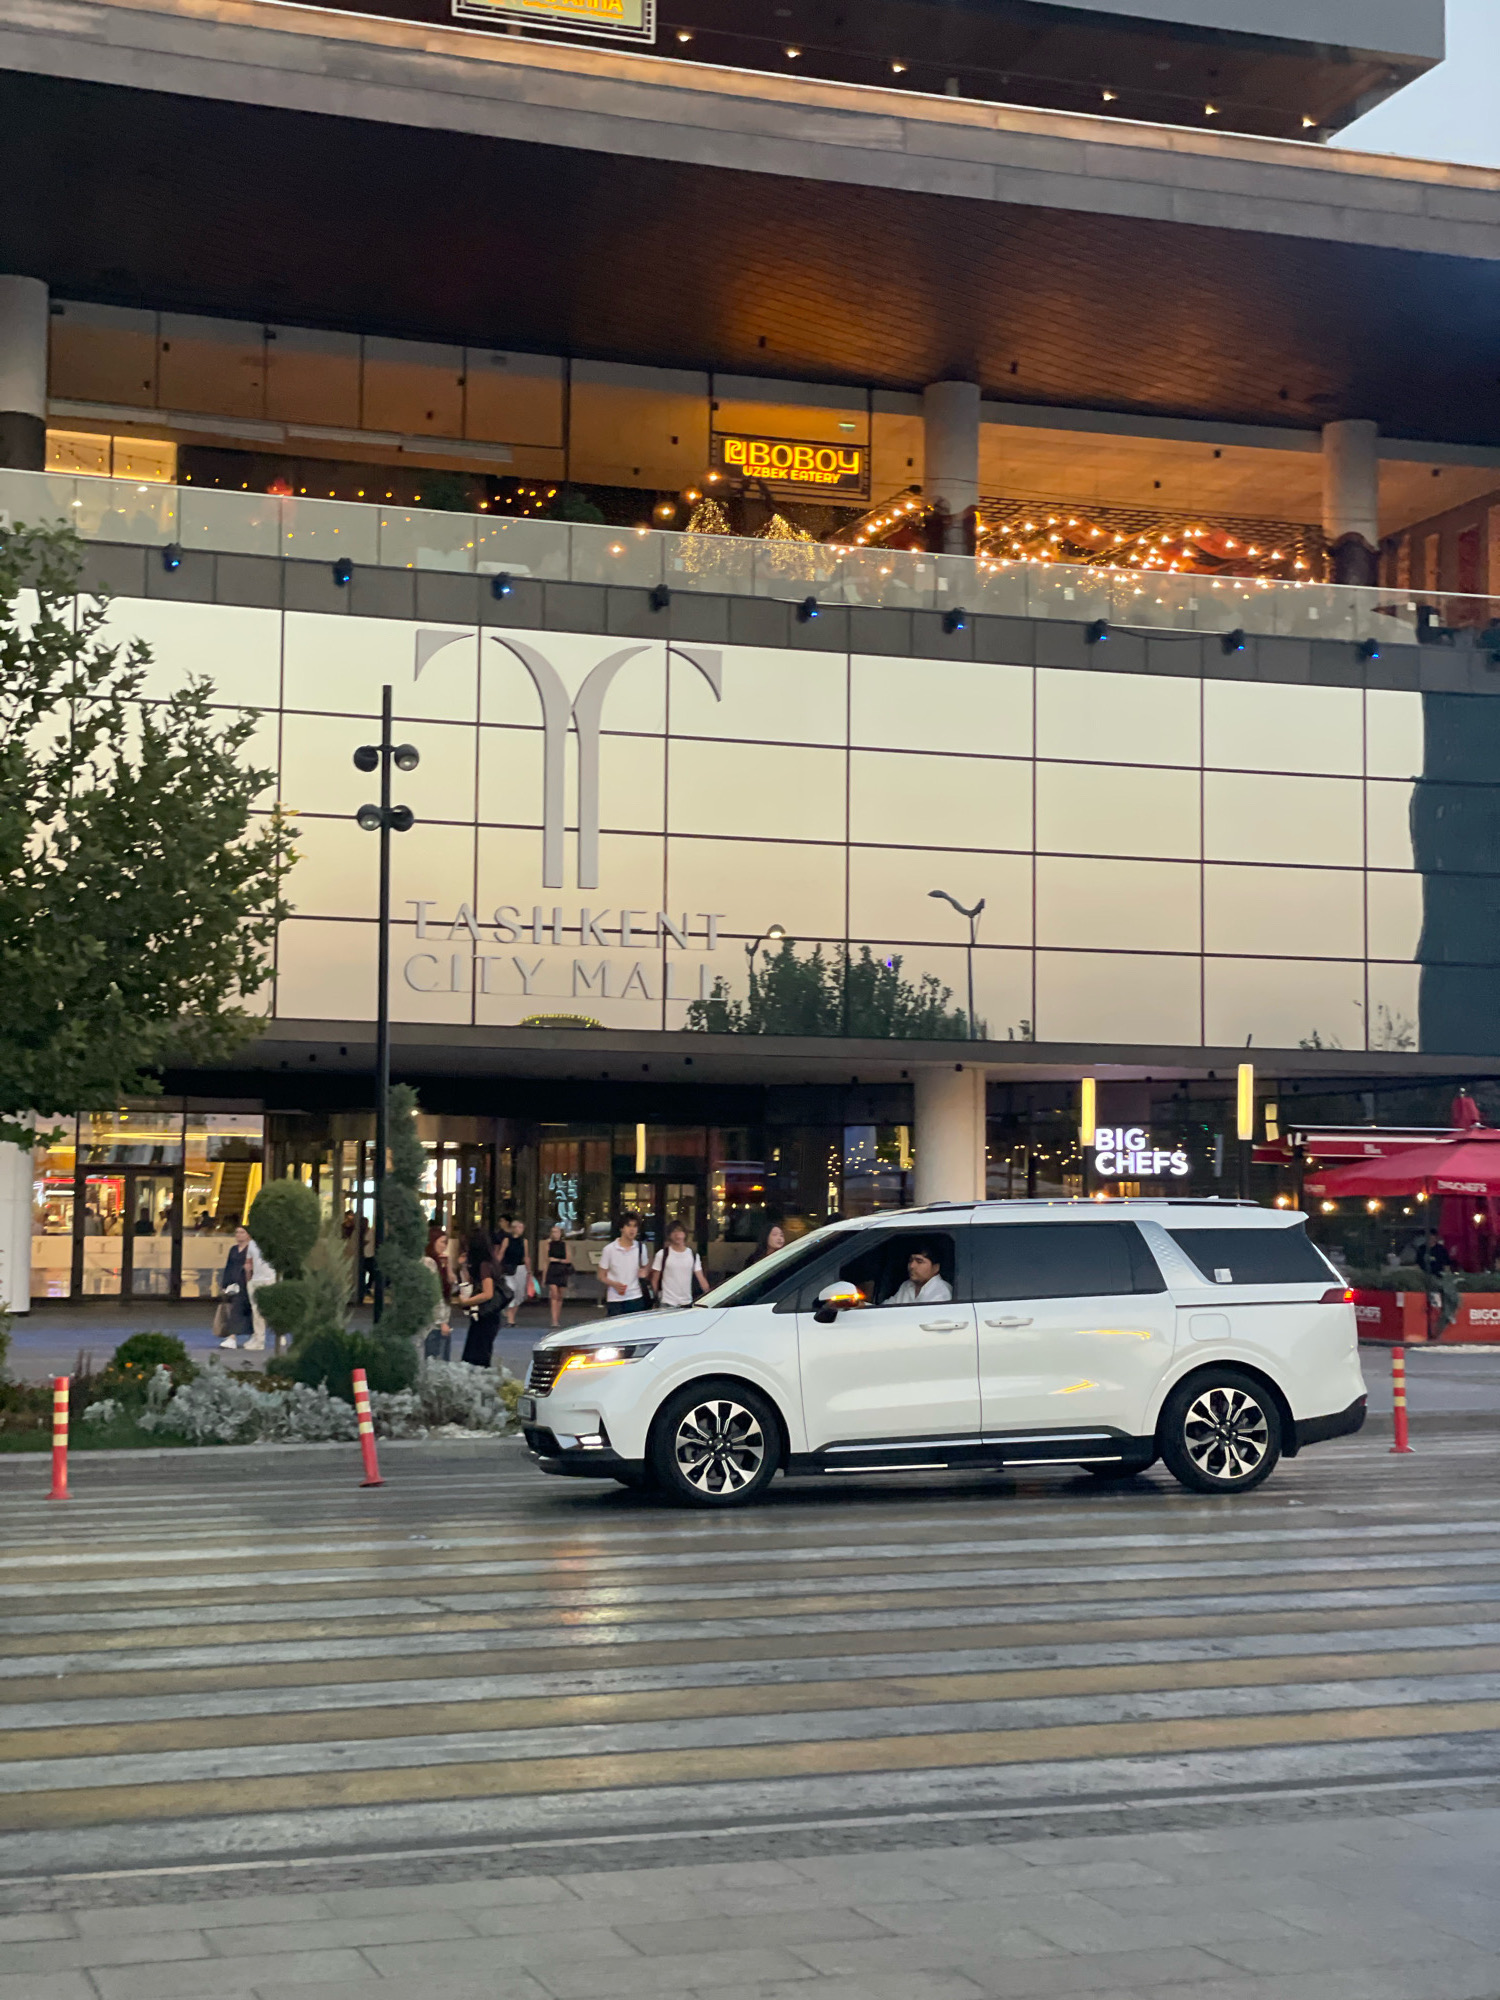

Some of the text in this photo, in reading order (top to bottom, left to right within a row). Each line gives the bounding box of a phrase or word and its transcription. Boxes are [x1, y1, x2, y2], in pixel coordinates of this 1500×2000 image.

[749, 442, 859, 475] BOBOY
[742, 465, 841, 484] UZBEK EATERY
[405, 900, 727, 951] TASHKENT
[403, 953, 727, 1001] CITY MALL
[1095, 1128, 1146, 1151] BIG
[1095, 1151, 1189, 1175] CHEFS
